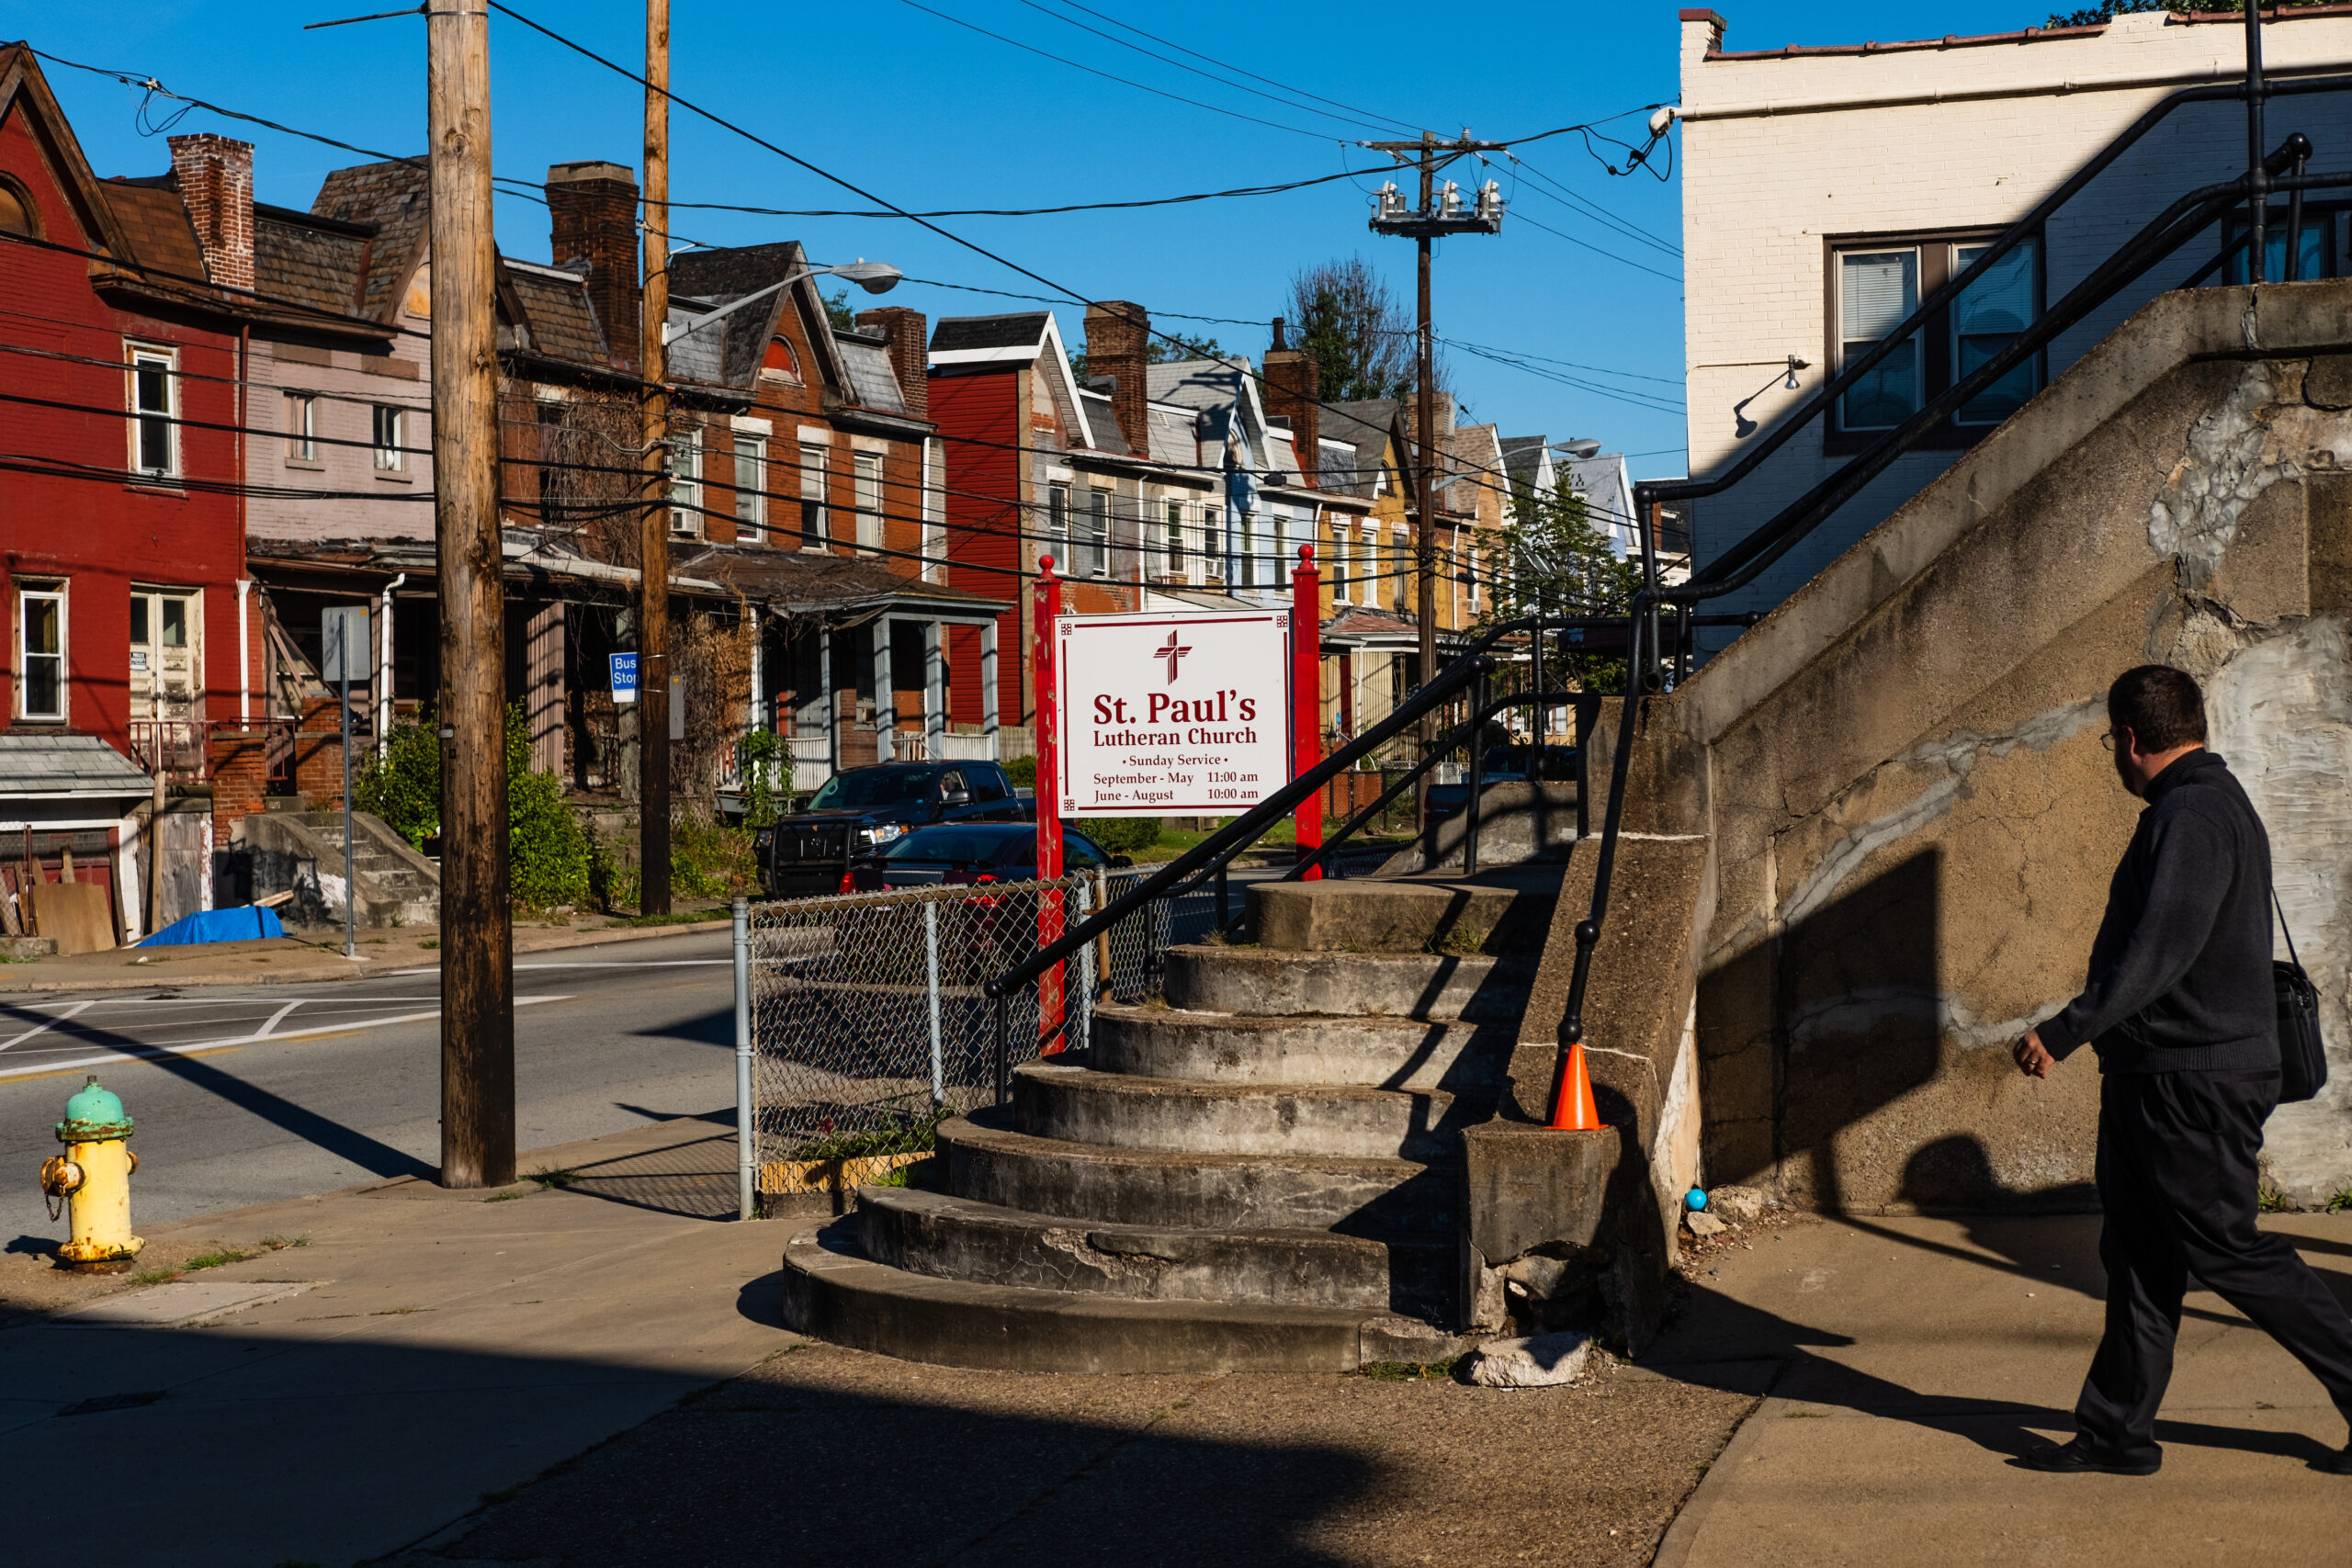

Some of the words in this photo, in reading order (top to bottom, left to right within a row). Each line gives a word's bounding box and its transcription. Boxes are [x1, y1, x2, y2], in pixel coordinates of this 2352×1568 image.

[615, 658, 637, 670] Bus
[614, 671, 639, 685] Stop
[1093, 694, 1136, 725] St.
[1147, 690, 1257, 724] Paul's
[1093, 729, 1182, 747] Lutheran
[1187, 727, 1258, 745] Church
[1129, 754, 1173, 770] Sunday
[1177, 753, 1221, 766] Service
[1093, 773, 1158, 788] September
[1168, 772, 1194, 787] May
[1207, 771, 1238, 783] 11:00
[1239, 773, 1259, 783] am
[1094, 790, 1122, 804] June
[1132, 789, 1174, 804] August
[1207, 788, 1238, 799] 10:00
[1240, 790, 1259, 799] am
